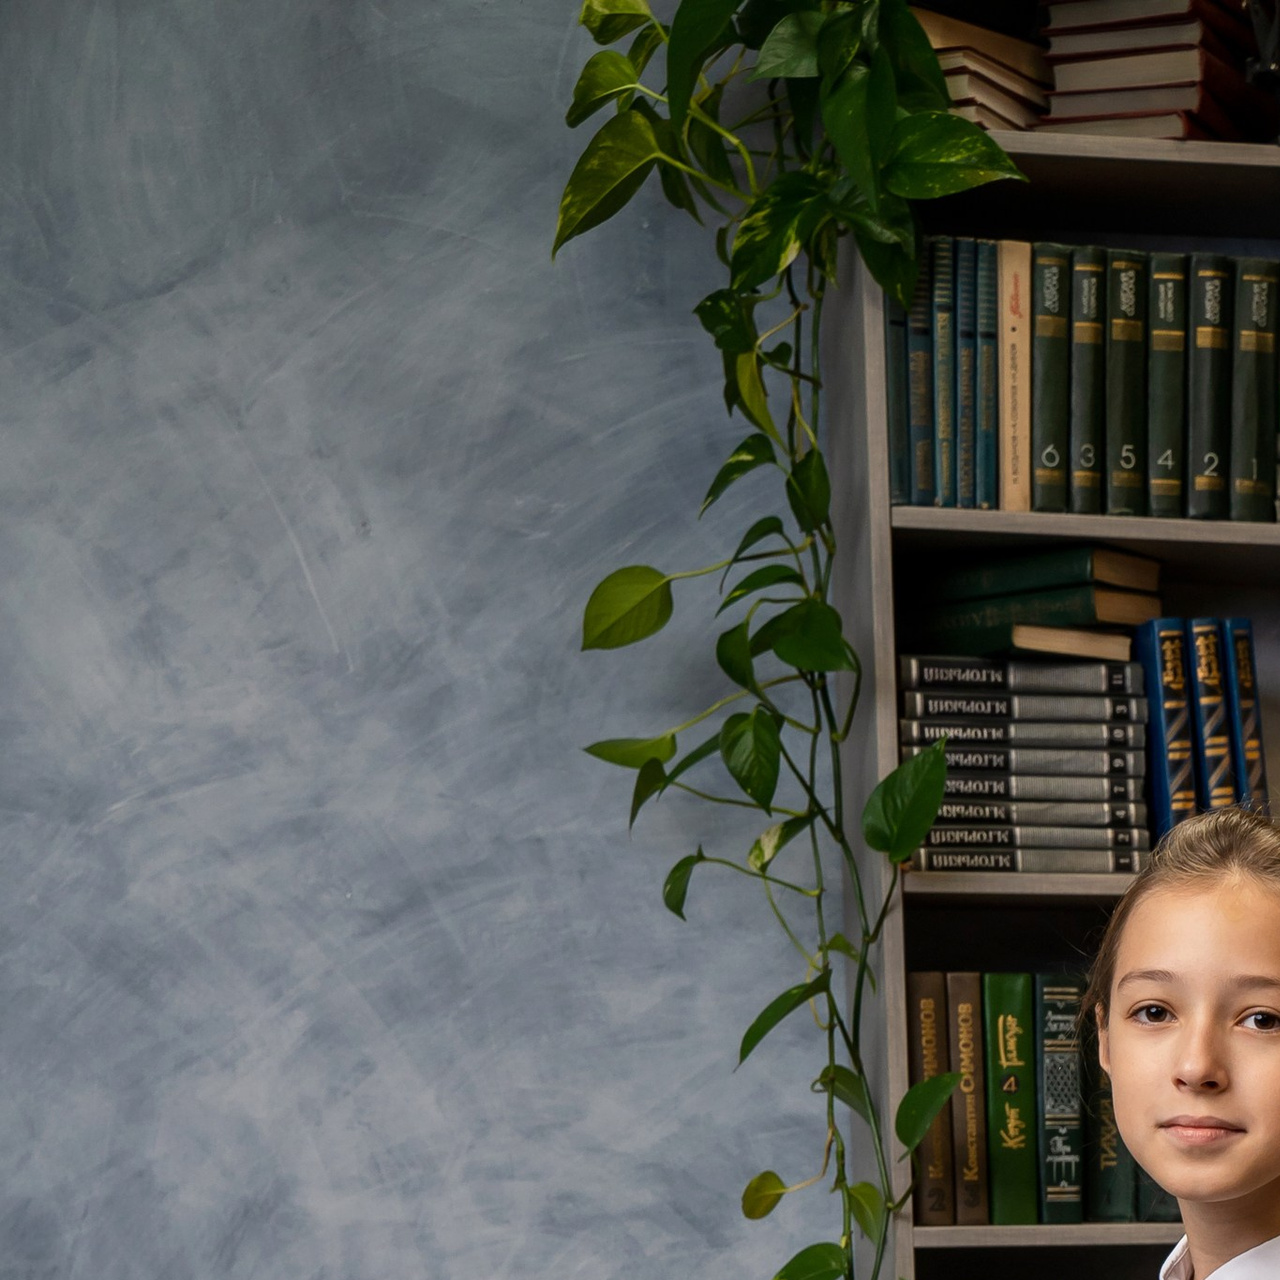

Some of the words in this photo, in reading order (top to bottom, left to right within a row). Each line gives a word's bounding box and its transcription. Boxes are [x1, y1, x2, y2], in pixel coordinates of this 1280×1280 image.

[1041, 444, 1060, 468] 6
[1080, 444, 1095, 467] 3
[1120, 445, 1136, 469] 5
[1157, 449, 1175, 470] 4
[1203, 452, 1219, 476] 2
[923, 667, 1003, 683] М.ГОРЬКИЙ
[928, 700, 1007, 714] М.ГОРЬКИЙ
[924, 727, 1004, 740] М.ГОРЬКИЙ
[945, 754, 1005, 768] М.ГОРЬК
[945, 780, 1005, 794] М.ГОРЬК
[930, 829, 1009, 844] М.ГОРЬКИЙ
[932, 854, 1011, 868] М.ГОРЬКИЙ
[920, 998, 938, 1084] ИМОНОВ
[957, 1003, 976, 1093] СИМОНОВ
[1003, 1076, 1018, 1093] 4
[963, 1095, 980, 1181] Константин
